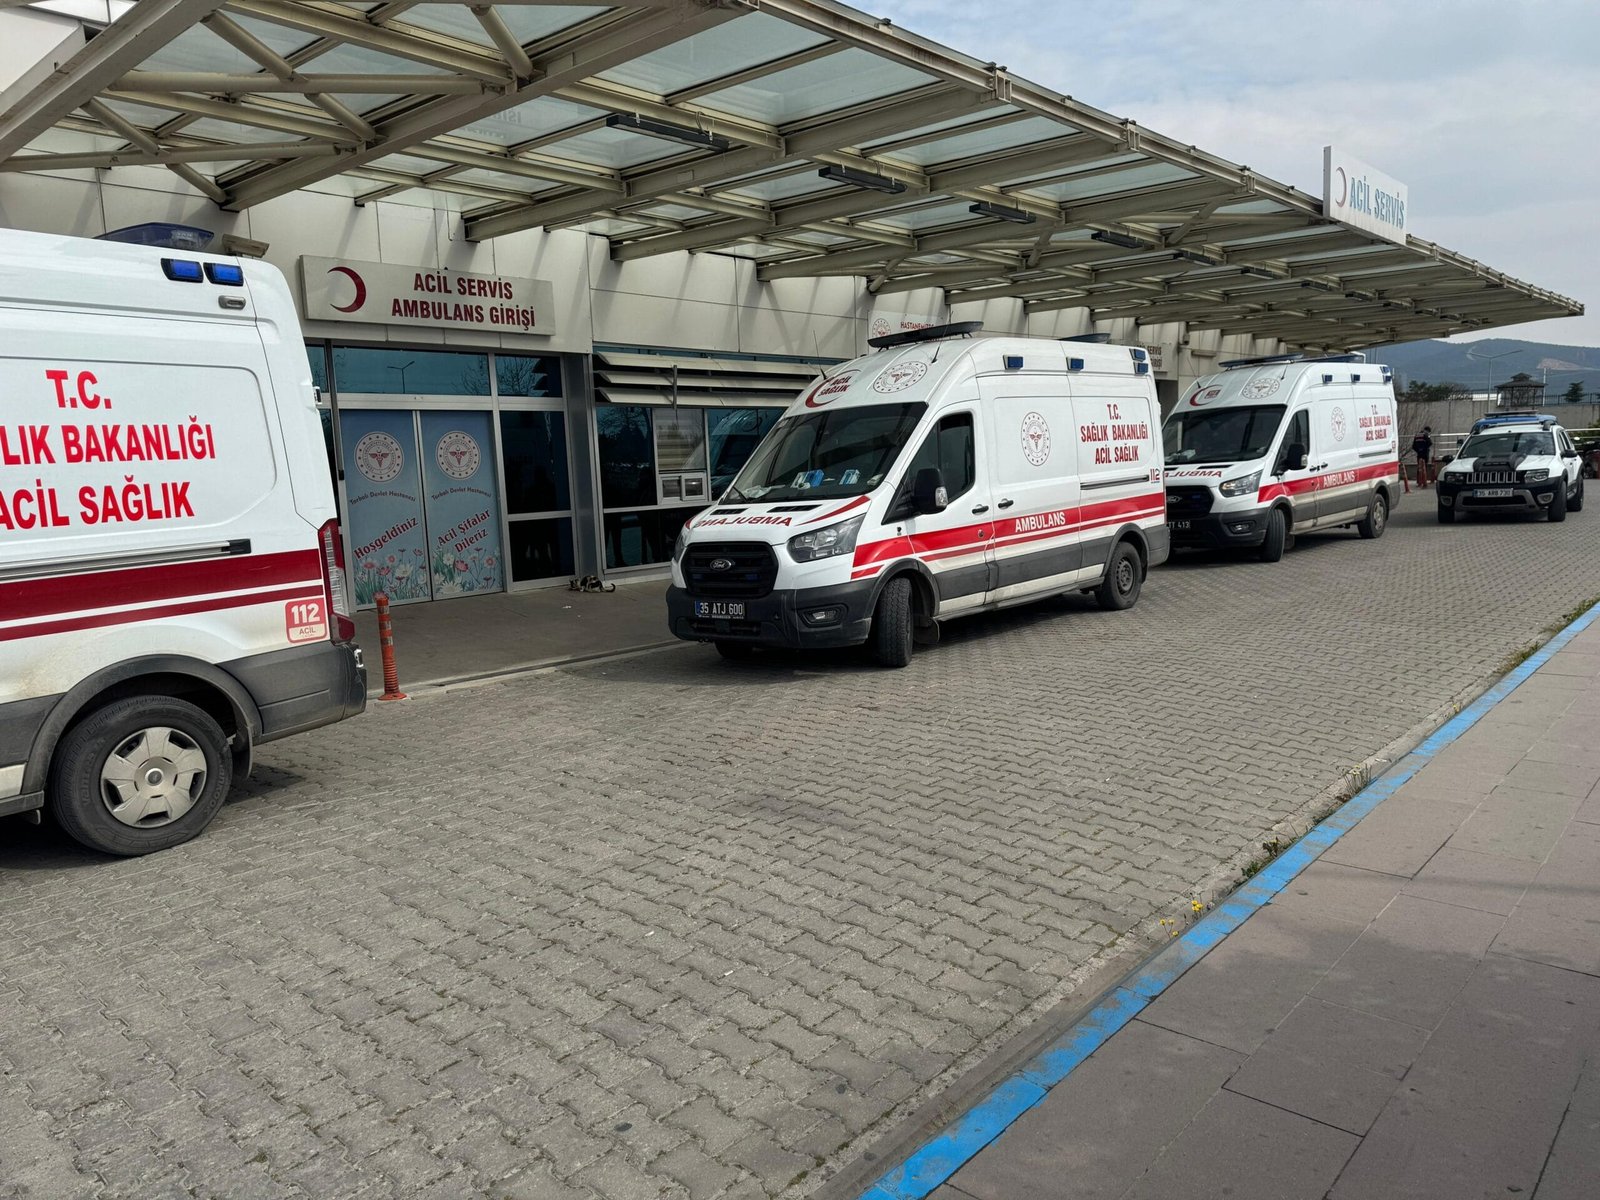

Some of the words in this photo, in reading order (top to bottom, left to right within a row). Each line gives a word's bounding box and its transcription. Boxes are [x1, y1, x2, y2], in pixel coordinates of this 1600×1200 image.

[1349, 175, 1372, 215] ACİL
[1374, 188, 1405, 230] SERVİS
[413, 270, 453, 294] ACİL
[456, 277, 513, 300] SERVİS
[391, 298, 485, 323] AMBULANS
[489, 303, 536, 331] GİRİŞİ
[45, 369, 112, 409] T.C.
[1107, 403, 1121, 420] T.C.
[61, 415, 216, 463] BAKANLIĞI
[1080, 421, 1109, 442] SAĞLIK
[1112, 421, 1149, 441] BAKANLIĞI
[1095, 444, 1112, 464] ACİL
[1114, 443, 1139, 463] SAĞLIK
[1150, 468, 1160, 481] 112
[1323, 470, 1355, 488] AMBULANS
[0, 478, 70, 530] ACİL
[79, 474, 195, 525] SAĞLIK
[437, 527, 458, 546] Acil
[457, 509, 491, 535] Şifalar
[1015, 511, 1066, 533] AMBULANS
[353, 517, 419, 559] Hoşgeldiniz
[454, 528, 489, 554] Dileriz
[291, 602, 320, 624] 112
[700, 602, 709, 614] 35
[712, 602, 726, 614] ATJ
[728, 603, 743, 615] 600
